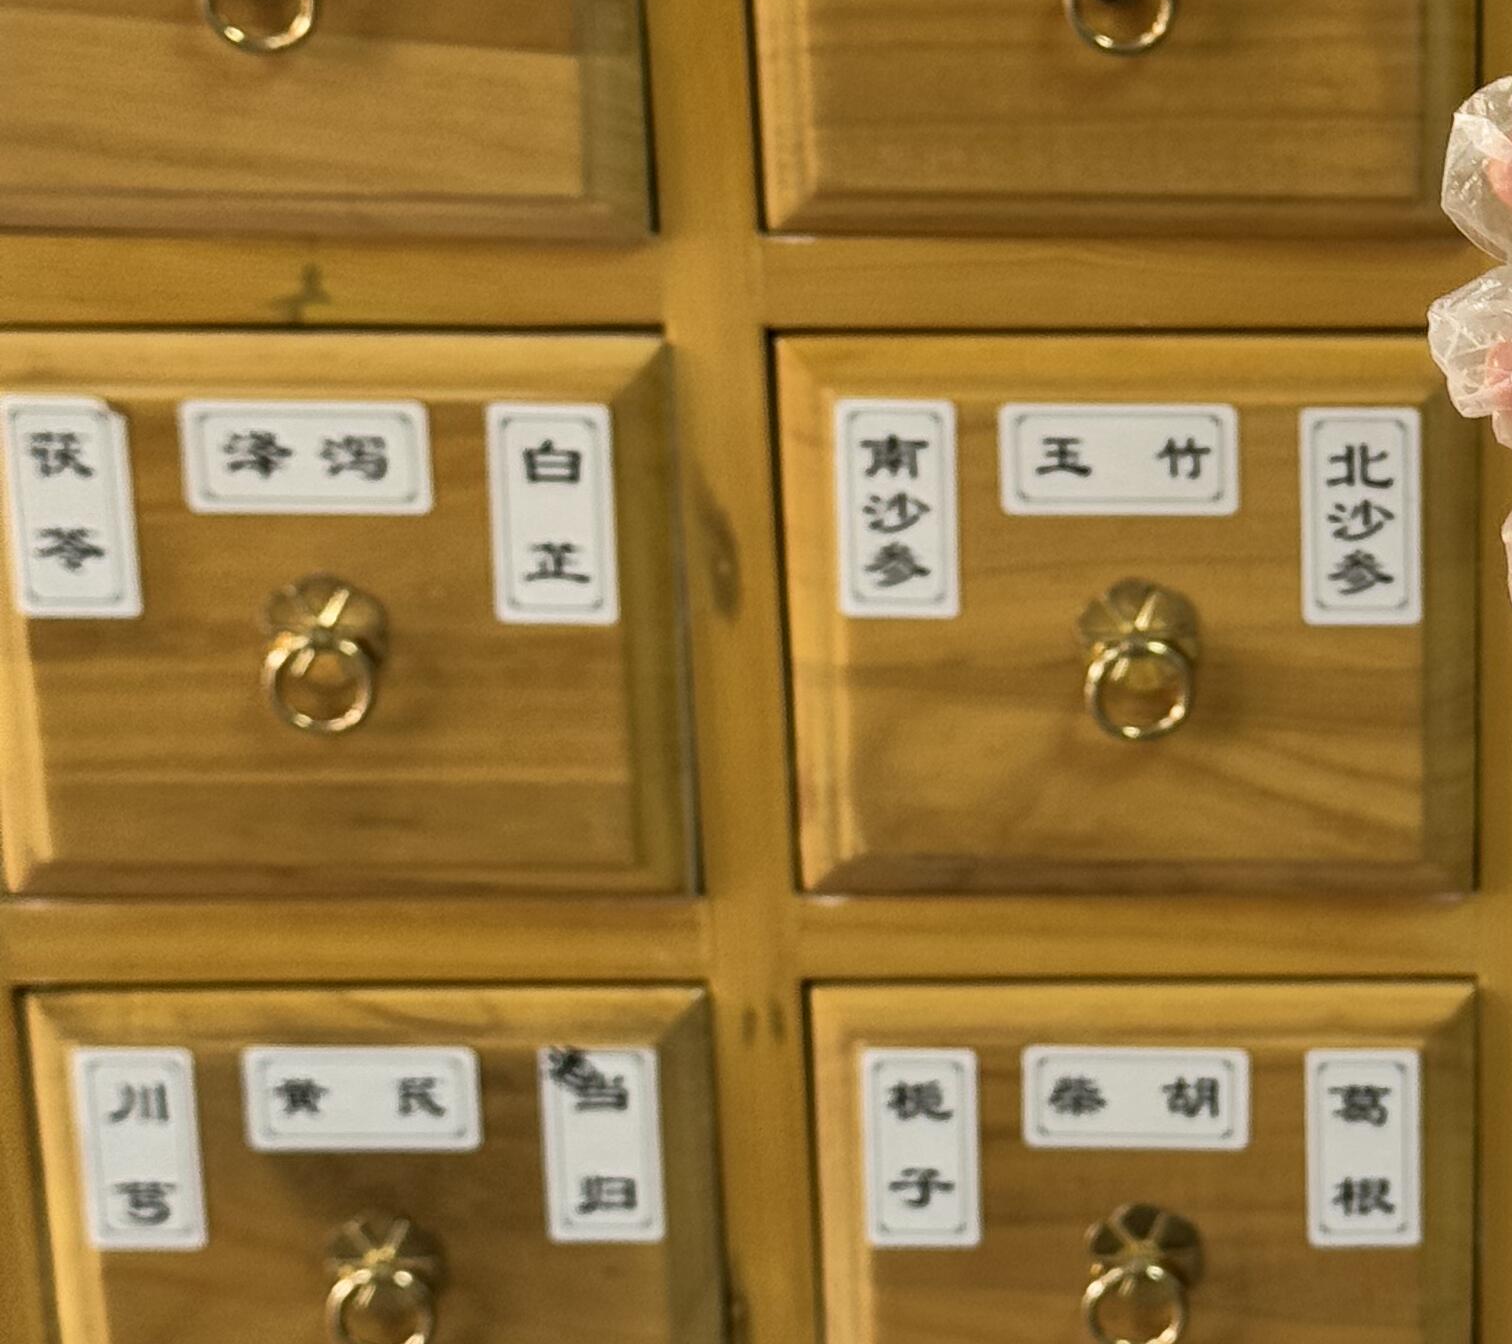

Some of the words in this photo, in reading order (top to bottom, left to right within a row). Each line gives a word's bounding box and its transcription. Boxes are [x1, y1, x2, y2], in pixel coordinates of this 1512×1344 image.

[858, 432, 933, 589] 南沙参
[1034, 435, 1213, 482] 玉竹
[1324, 441, 1397, 597] 北沙参
[1046, 1075, 1221, 1120] 柴胡
[1326, 1083, 1397, 1218] 葛根
